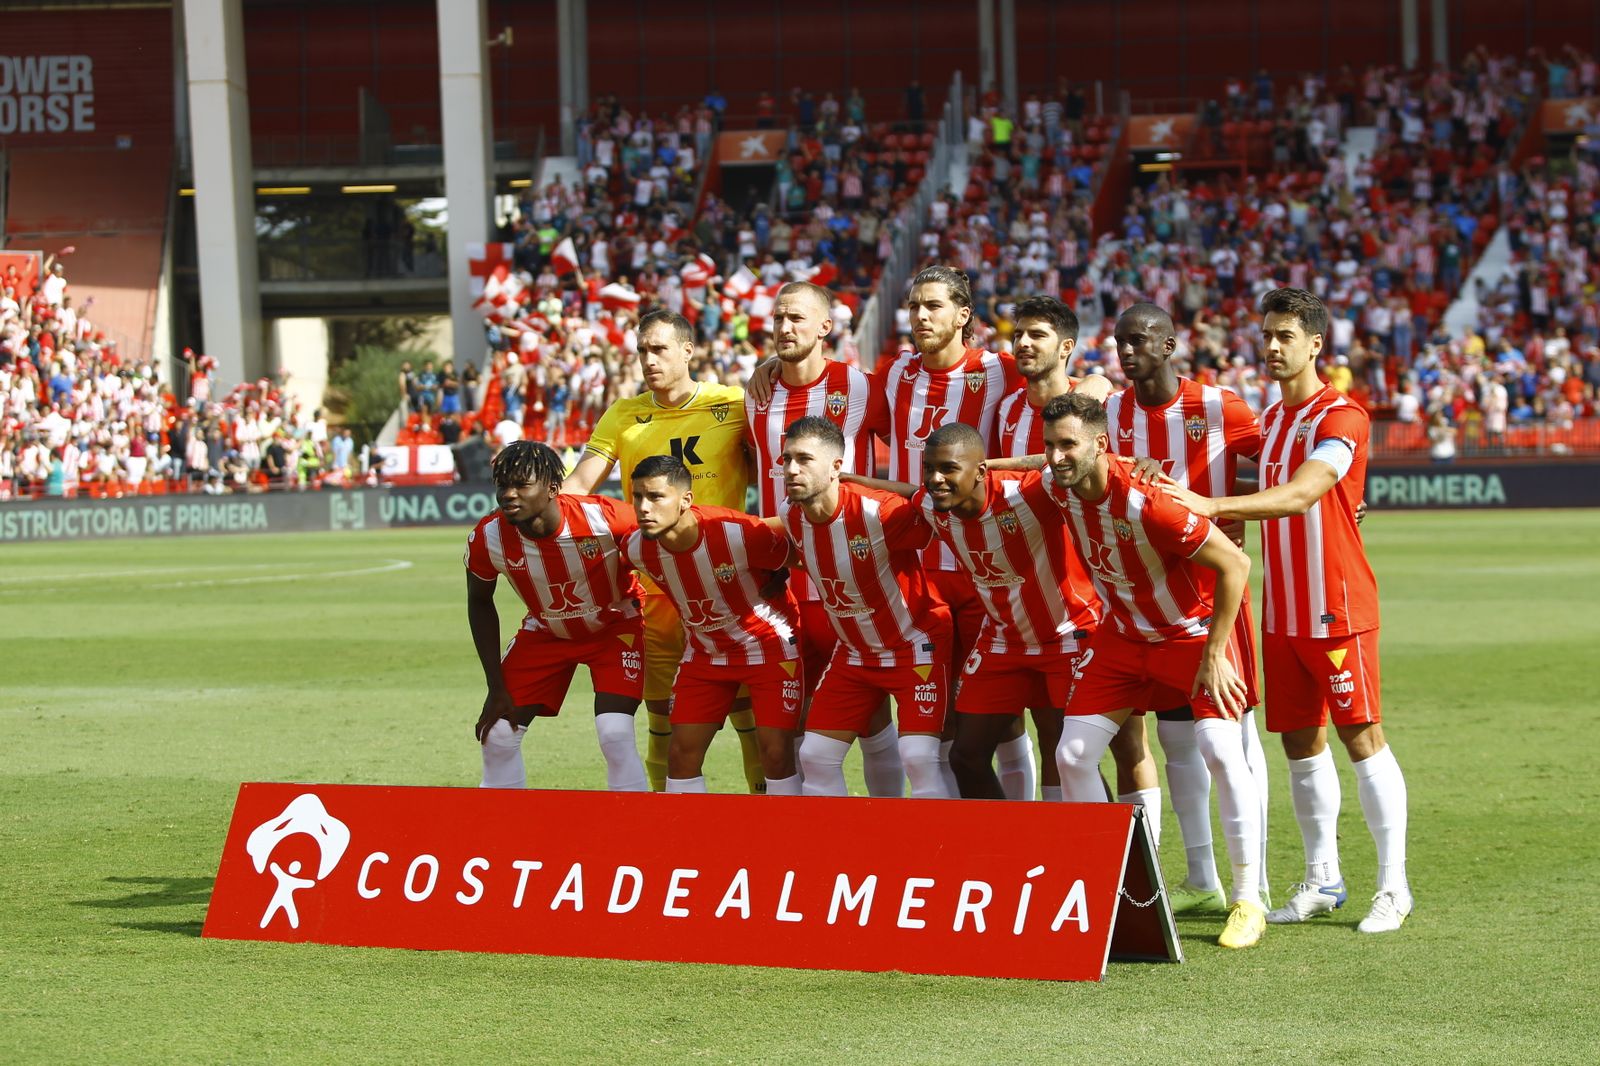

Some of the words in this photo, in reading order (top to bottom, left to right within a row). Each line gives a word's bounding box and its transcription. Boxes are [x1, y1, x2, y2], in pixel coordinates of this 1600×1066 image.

[1370, 474, 1506, 504] PRIMERA
[379, 494, 441, 522] UNA
[446, 493, 500, 519] CO
[0, 508, 139, 538] STRUCTORA
[143, 505, 171, 533] DE
[176, 503, 268, 530] PRIMERA
[622, 659, 641, 669] KUDU
[914, 691, 937, 702] KUDU
[1331, 681, 1354, 694] KUDU
